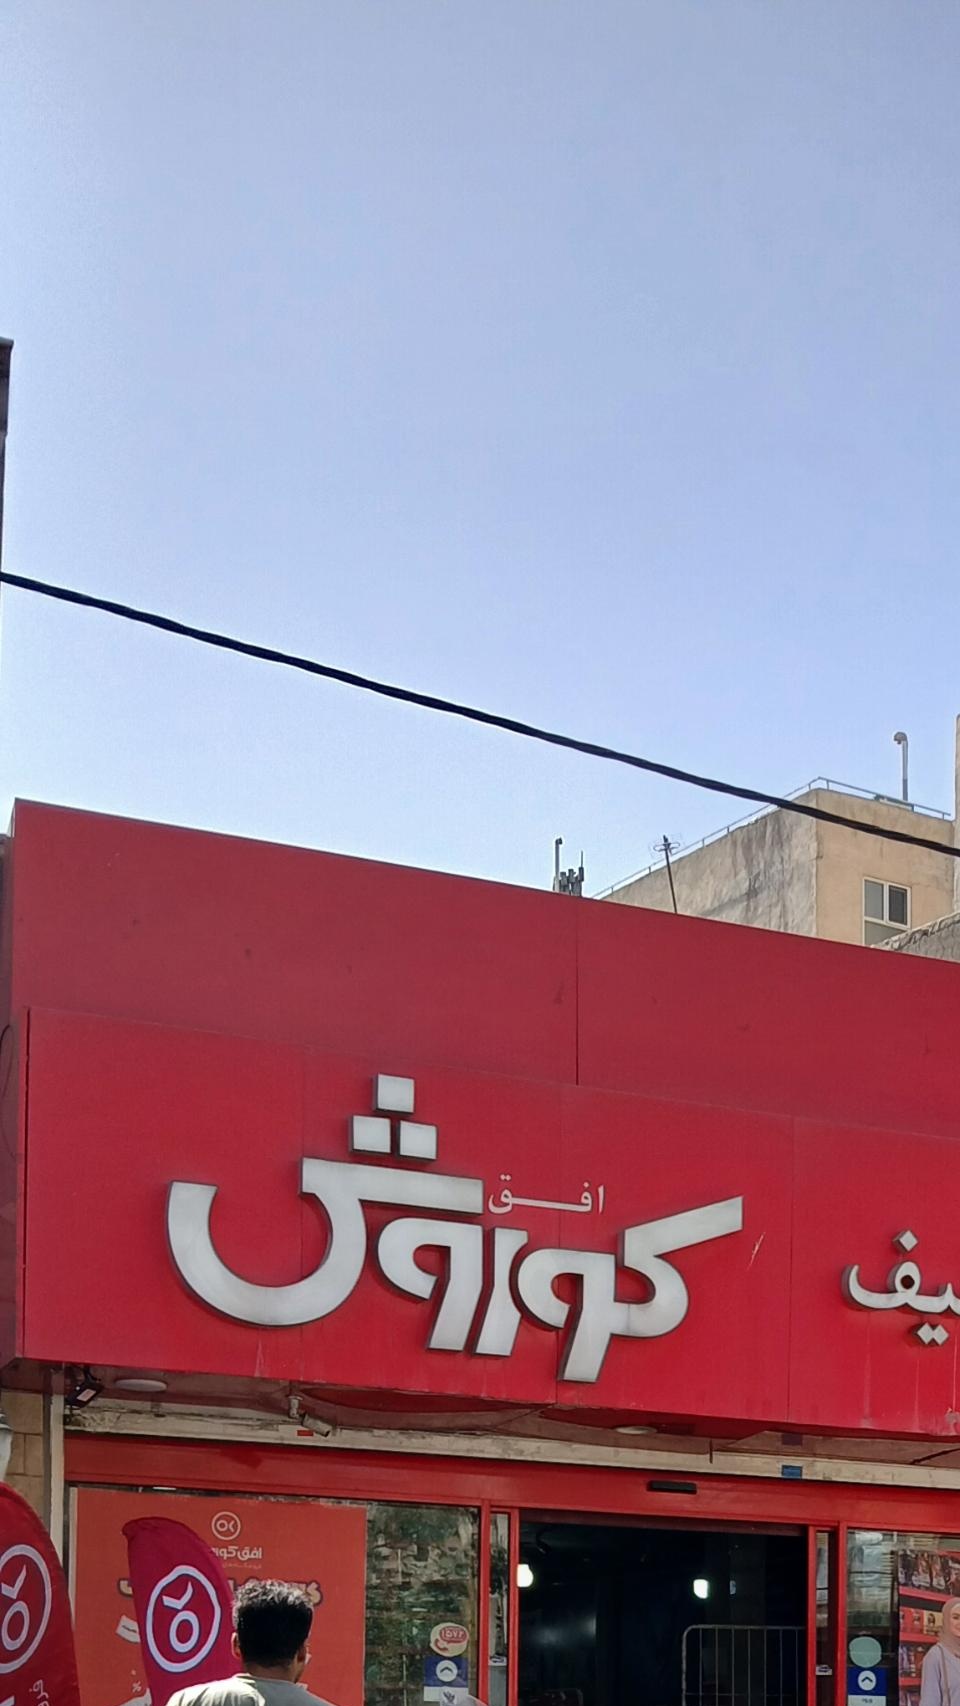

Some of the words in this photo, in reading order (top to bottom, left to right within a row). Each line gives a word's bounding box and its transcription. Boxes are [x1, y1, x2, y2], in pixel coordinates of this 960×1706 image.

[487, 1175, 604, 1214] افق
[166, 1074, 743, 1383] کوروش
[211, 1545, 238, 1560] کور
[237, 1546, 263, 1561] افق
